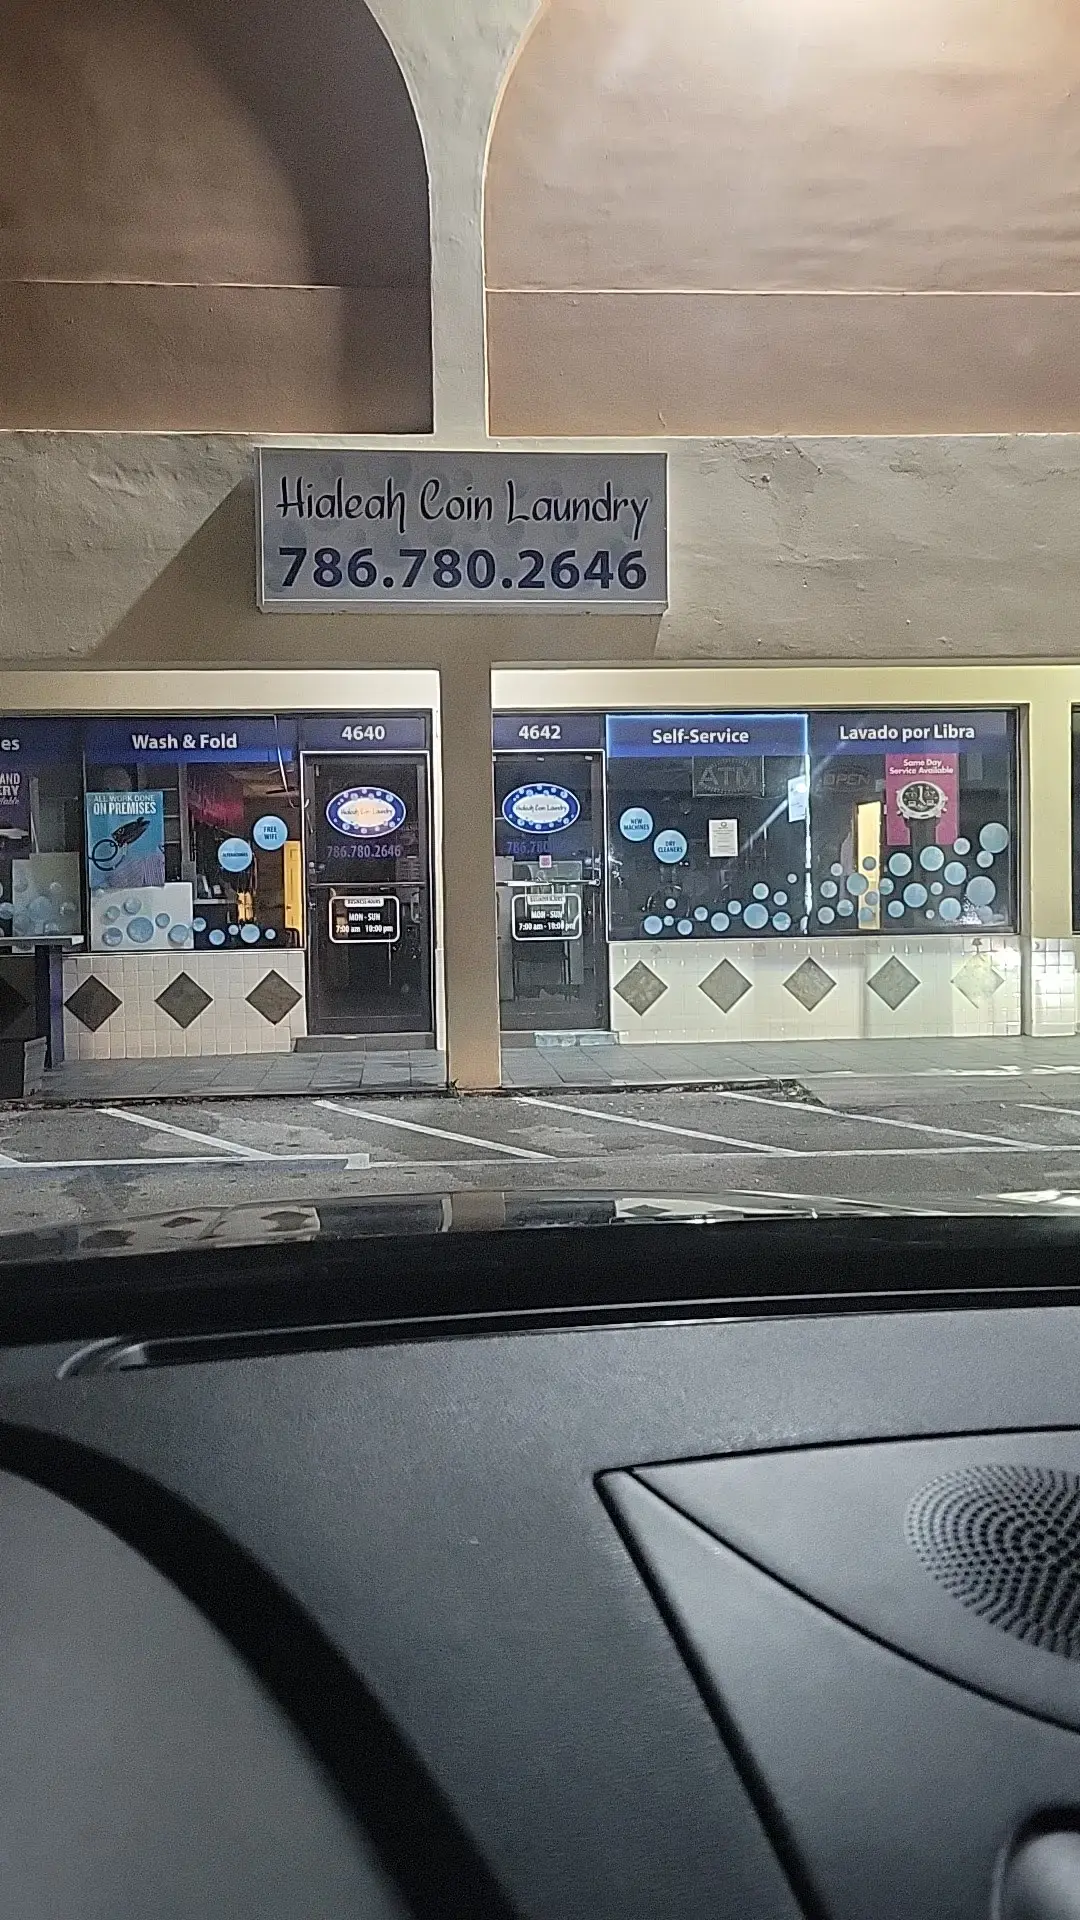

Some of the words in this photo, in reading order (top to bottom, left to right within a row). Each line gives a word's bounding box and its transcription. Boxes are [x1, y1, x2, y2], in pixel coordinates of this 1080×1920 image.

[276, 475, 406, 534] Hialeah
[420, 478, 493, 522] Coin
[506, 479, 649, 541] Laundry
[278, 546, 648, 590] 786.780.2646
[341, 725, 386, 741] 4640
[518, 724, 562, 740] 4642
[652, 727, 749, 744] Self-Service
[840, 724, 899, 740] Lavado
[902, 726, 931, 742] por
[933, 723, 975, 739] Libra
[131, 733, 179, 749] Wash
[182, 734, 196, 749] &
[199, 733, 238, 749] Fold
[889, 767, 917, 775] Service
[918, 766, 954, 775] Available
[903, 758, 925, 767] Same
[926, 758, 942, 768] Day
[699, 765, 758, 786] ATM
[134, 794, 155, 802] DONE
[93, 802, 107, 815] ON
[108, 801, 157, 815] PREMISES
[327, 844, 402, 858] 786.780.2646
[348, 912, 364, 921] MON
[368, 912, 381, 921] SUN
[336, 924, 350, 933] 7:00
